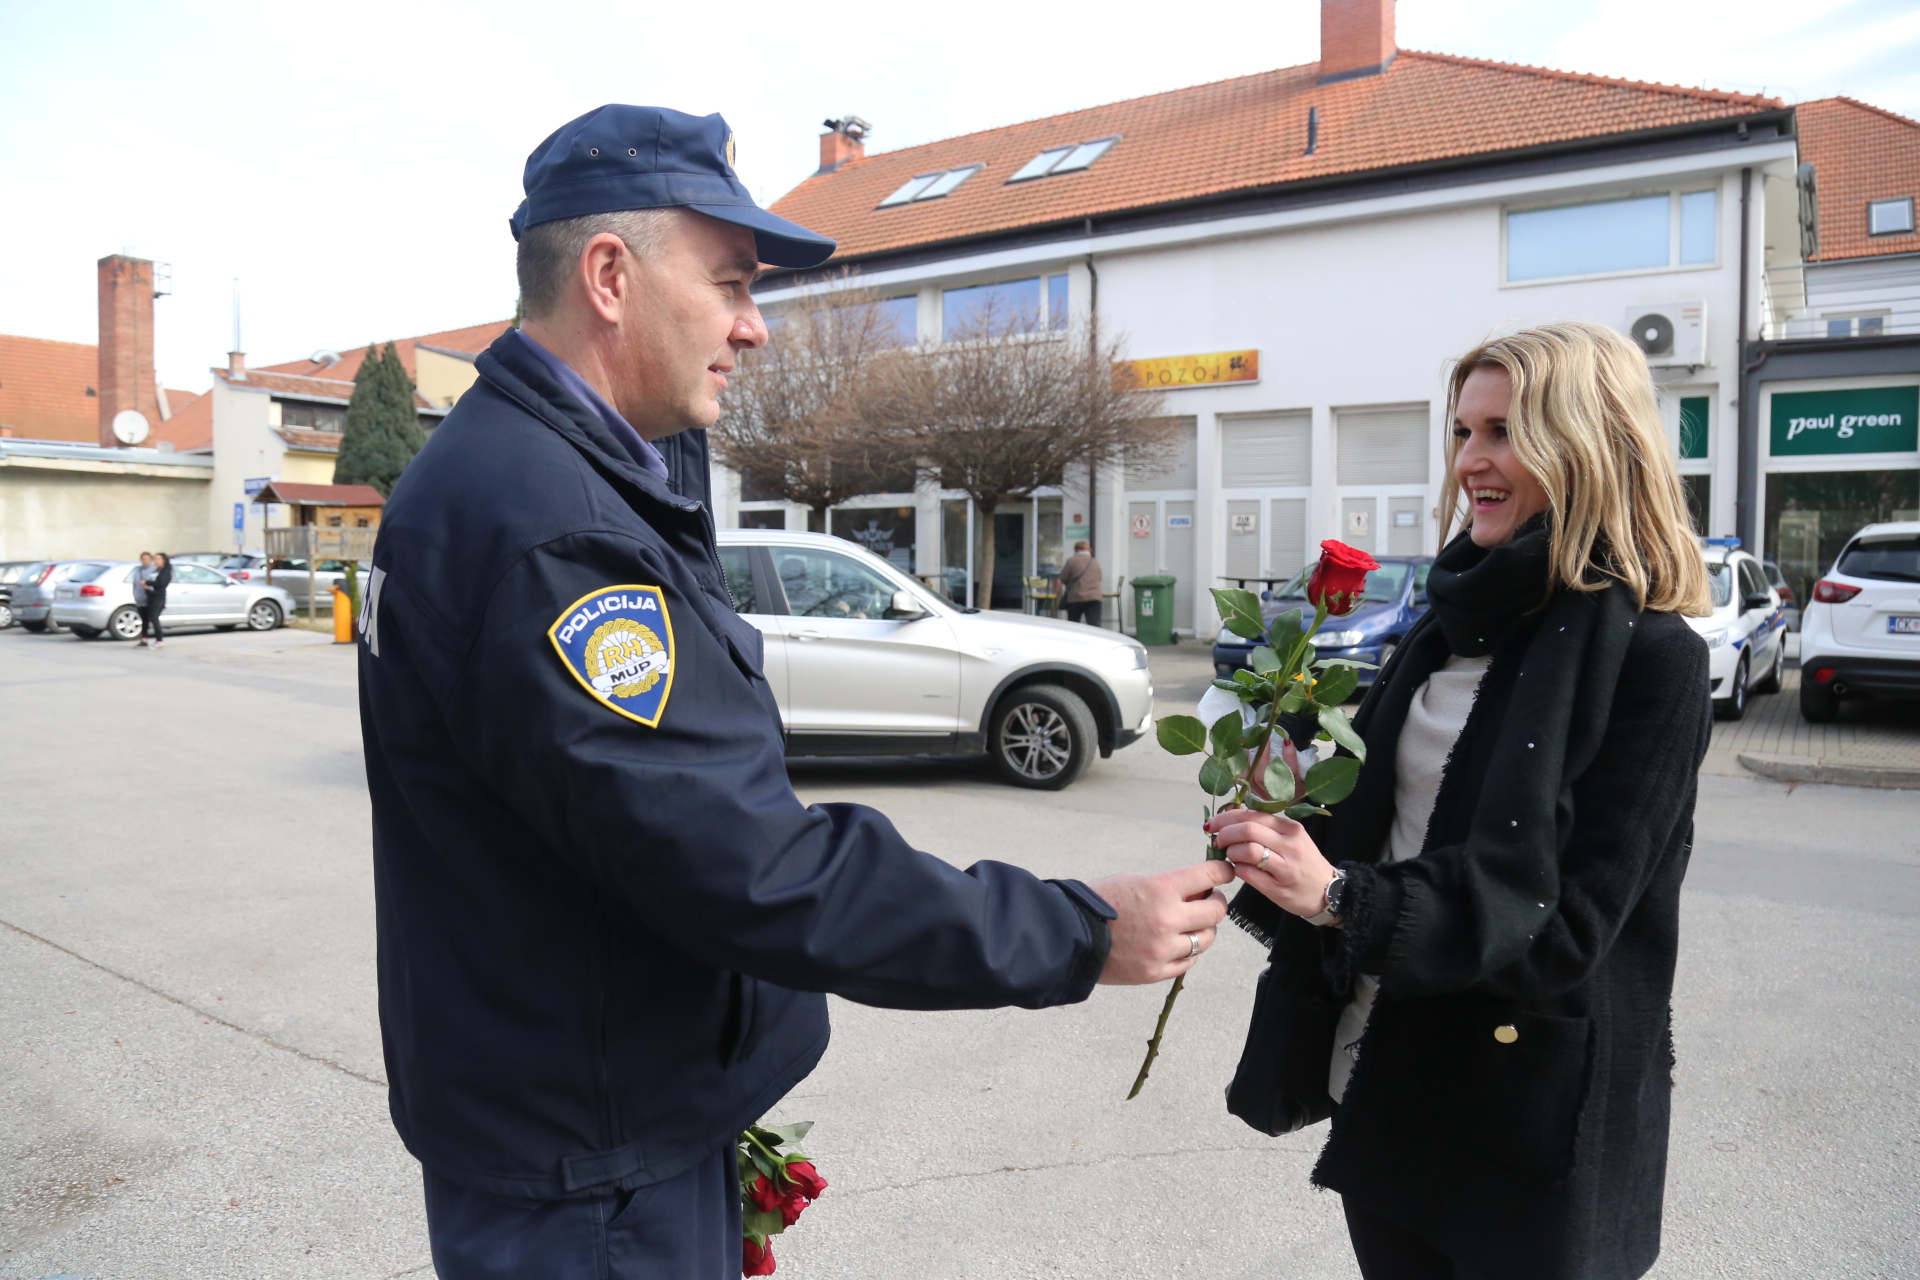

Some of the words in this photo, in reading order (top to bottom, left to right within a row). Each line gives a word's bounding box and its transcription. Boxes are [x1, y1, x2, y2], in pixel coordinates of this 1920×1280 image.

[1146, 366, 1220, 385] POZOJ
[1786, 414, 1834, 440] paul
[1837, 414, 1902, 438] green
[558, 595, 657, 644] POLICIJA
[602, 638, 643, 668] RH
[610, 660, 651, 683] MUP
